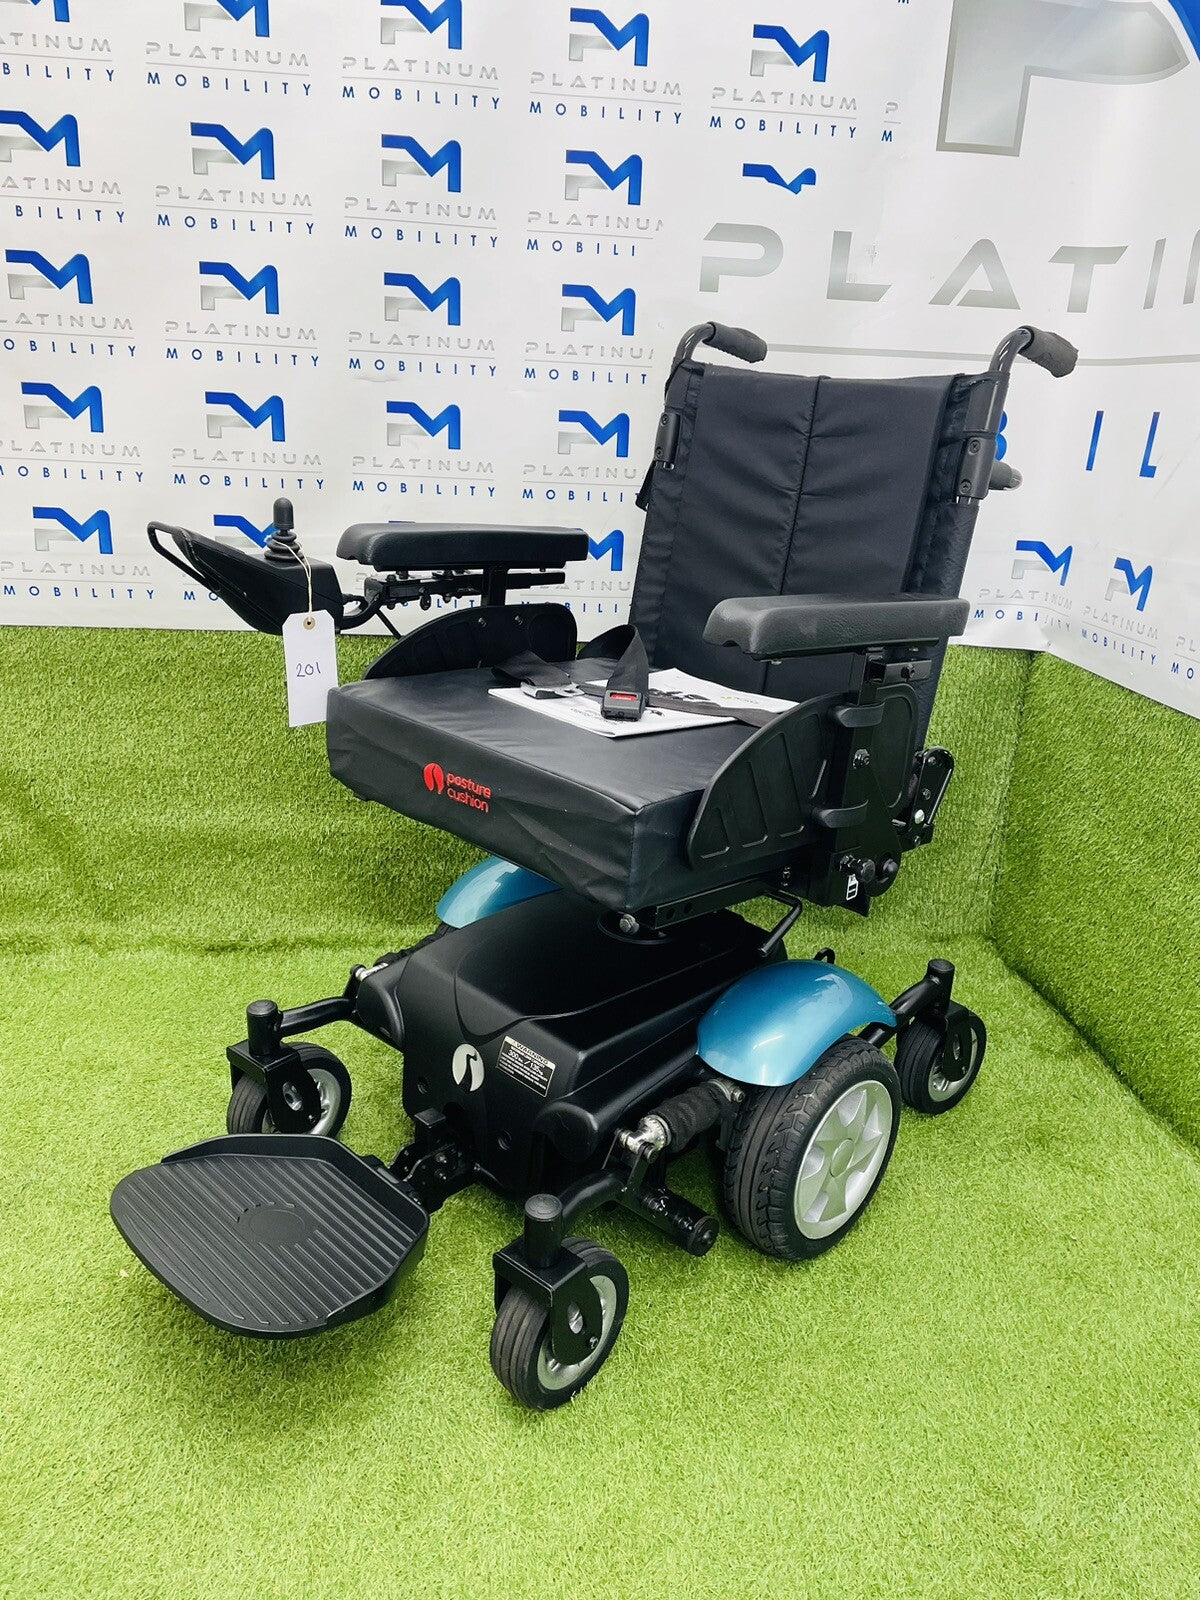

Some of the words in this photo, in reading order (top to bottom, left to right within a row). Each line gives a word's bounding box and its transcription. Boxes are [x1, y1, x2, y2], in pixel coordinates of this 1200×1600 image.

[145, 41, 309, 67] PLATINUM
[2, 62, 114, 82] BILITY
[342, 56, 498, 80] PLATINUM
[147, 72, 311, 96] MOBILITY
[530, 71, 682, 96] PLATINUM
[342, 86, 500, 110] MOBILITY
[712, 87, 857, 111] PLATINUM
[529, 101, 682, 124] MOBILITY
[710, 116, 856, 138] MOBILITY
[1, 176, 121, 195] ATINUM
[155, 185, 312, 207] PLATINUM
[15, 205, 125, 223] BILITY
[344, 197, 497, 220] PLATINUM
[157, 214, 314, 235] MOBILITY
[345, 225, 499, 248] MOBILITY
[527, 239, 635, 256] MOBILI
[165, 321, 317, 341] PLATINUM
[349, 331, 495, 351] PLATINUM
[3, 338, 136, 357] OBILITY
[165, 348, 319, 367] MOBILITY
[525, 342, 653, 359] PLATINU
[349, 358, 496, 377] MOBILITY
[524, 368, 647, 384] MOBILIT
[0, 440, 141, 457] LATINUM
[172, 448, 322, 466] PLATINUM
[353, 456, 494, 473] PLATINUM
[523, 464, 646, 479] PLATINU
[173, 473, 324, 489] MOBILITY
[353, 481, 495, 497] MOBILITY
[0, 561, 151, 577] PLATINUM
[3, 585, 154, 600] MOBILITY
[979, 588, 1072, 610] PLATINUM
[1083, 606, 1158, 640] PLATINUM
[1081, 628, 1156, 665] MOBILITY
[296, 661, 321, 677] 201
[447, 773, 491, 798] posture
[447, 788, 489, 813] cushion
